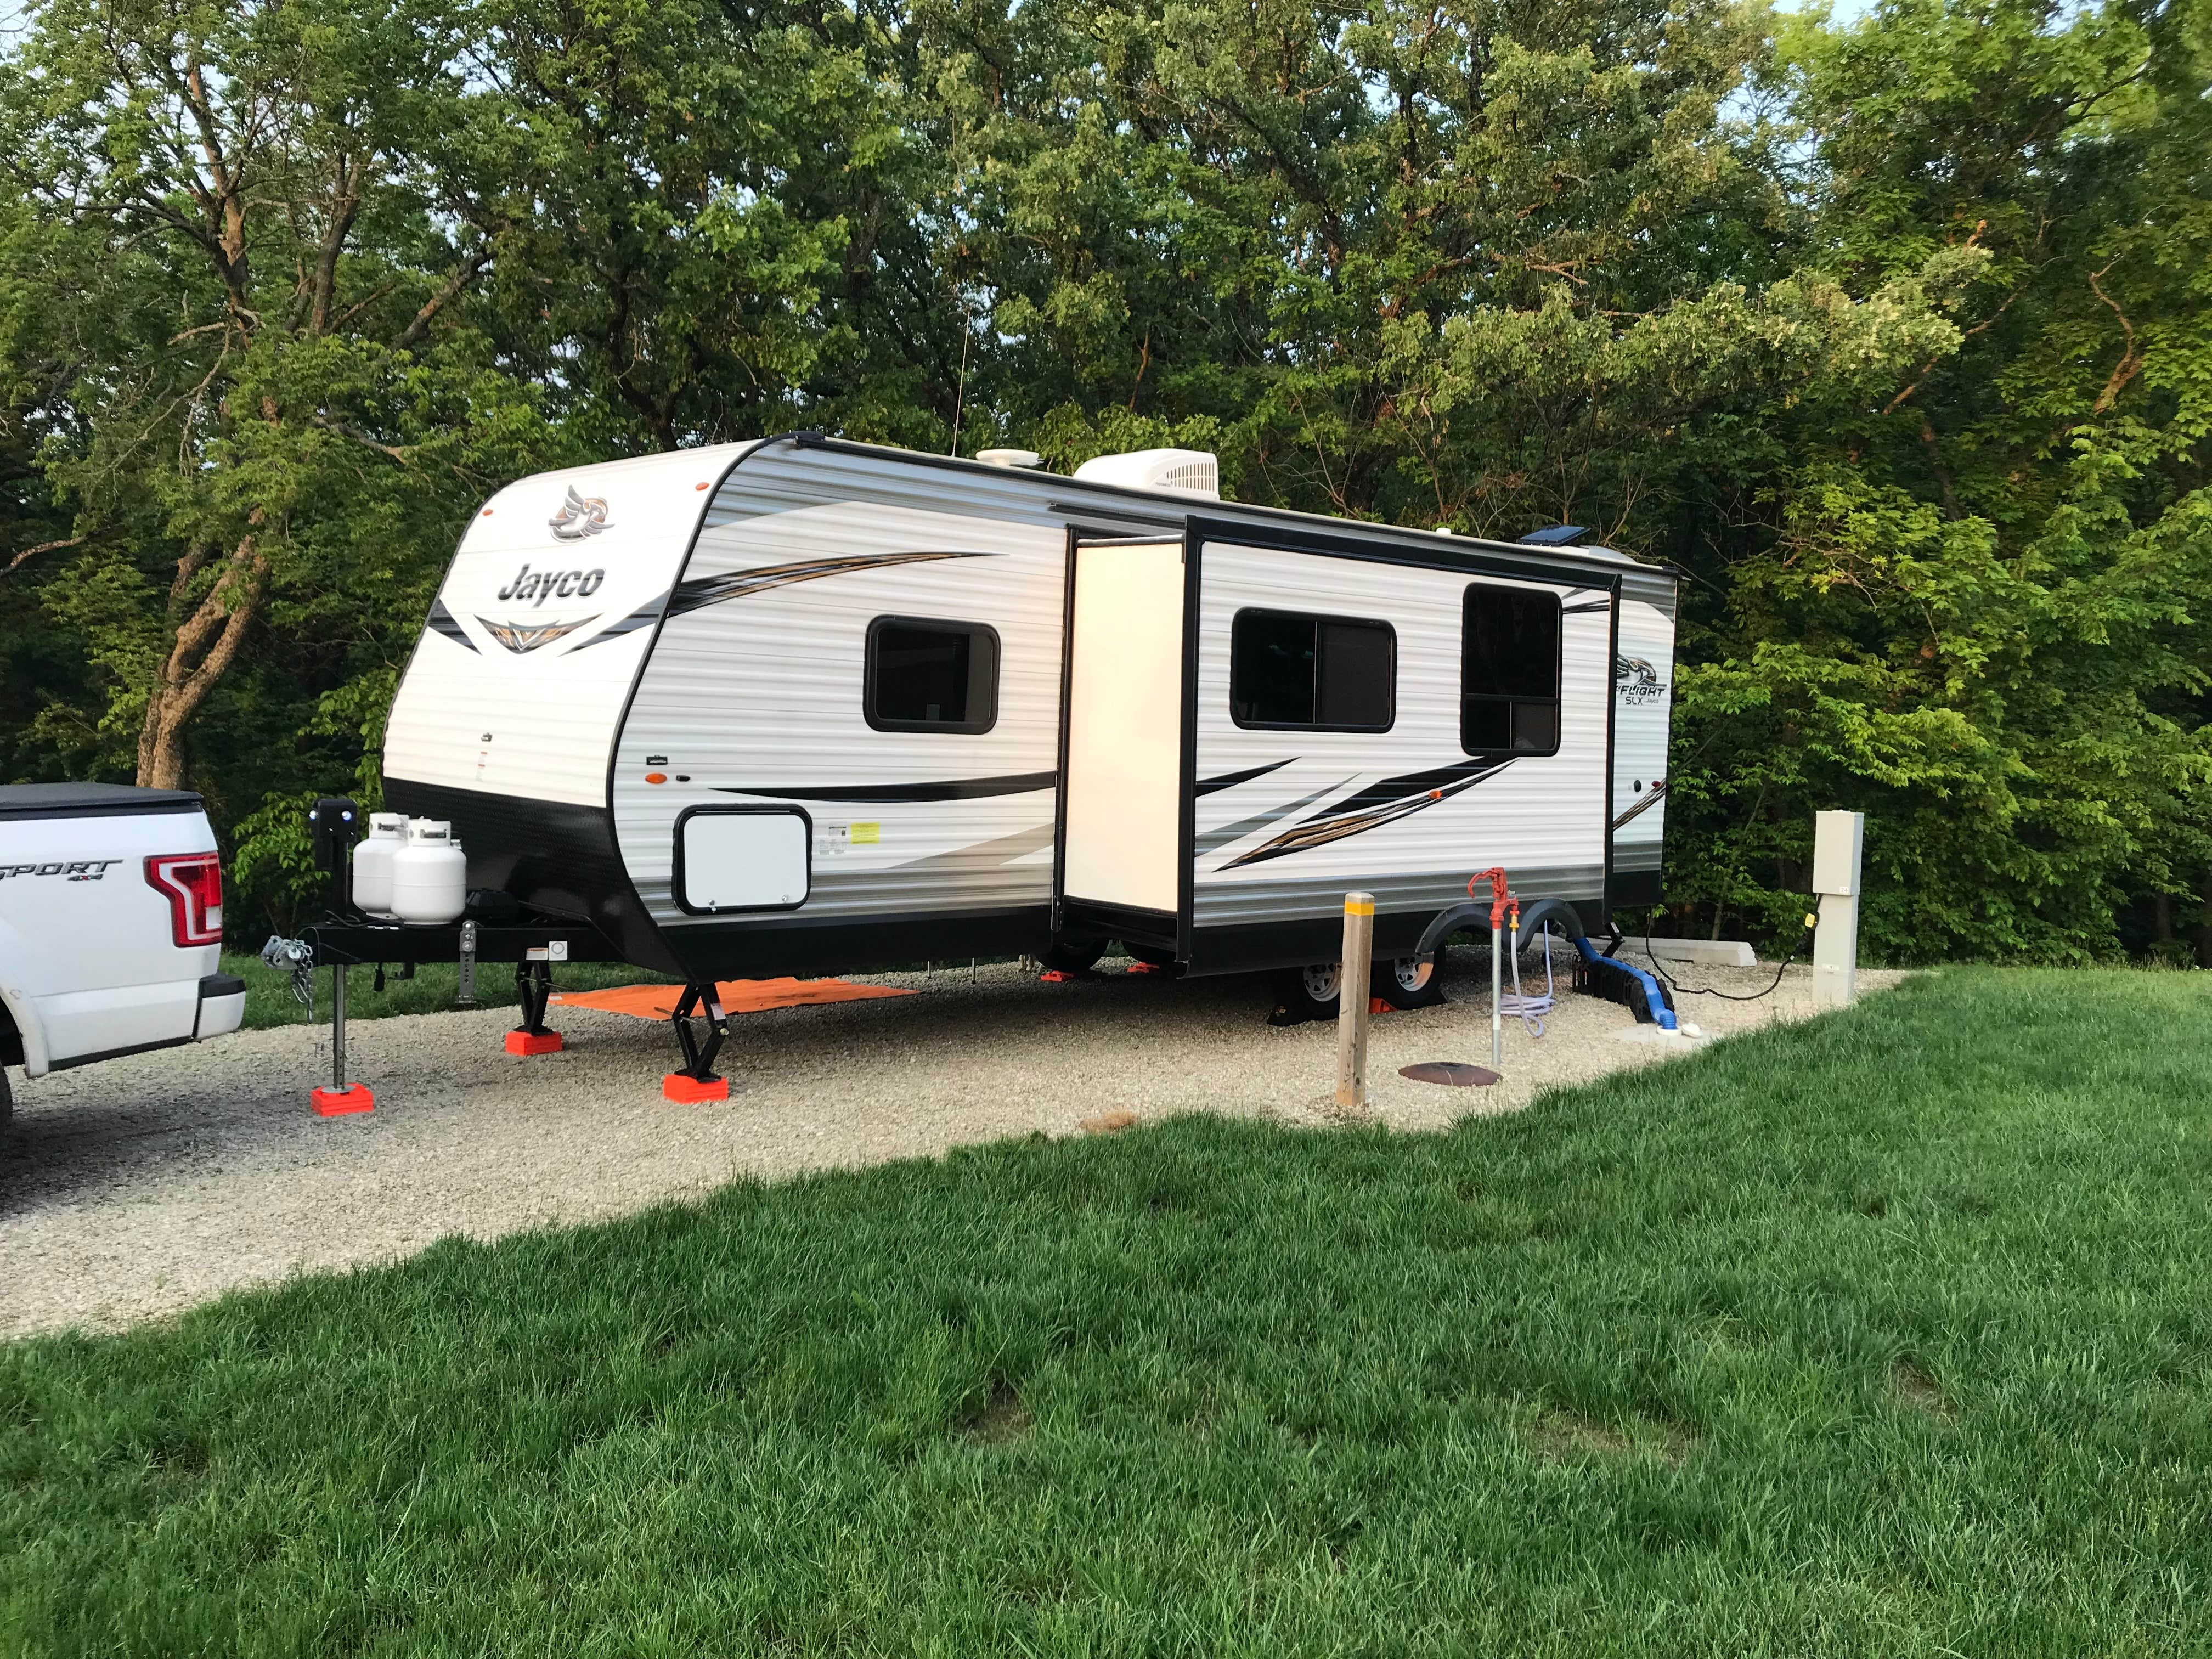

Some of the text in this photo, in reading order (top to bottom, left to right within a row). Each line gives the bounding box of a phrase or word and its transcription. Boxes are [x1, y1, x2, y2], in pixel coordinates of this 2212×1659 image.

[496, 563, 606, 608] Jayco
[1620, 685, 1665, 697] FLIGHT
[1626, 696, 1643, 705] SLX
